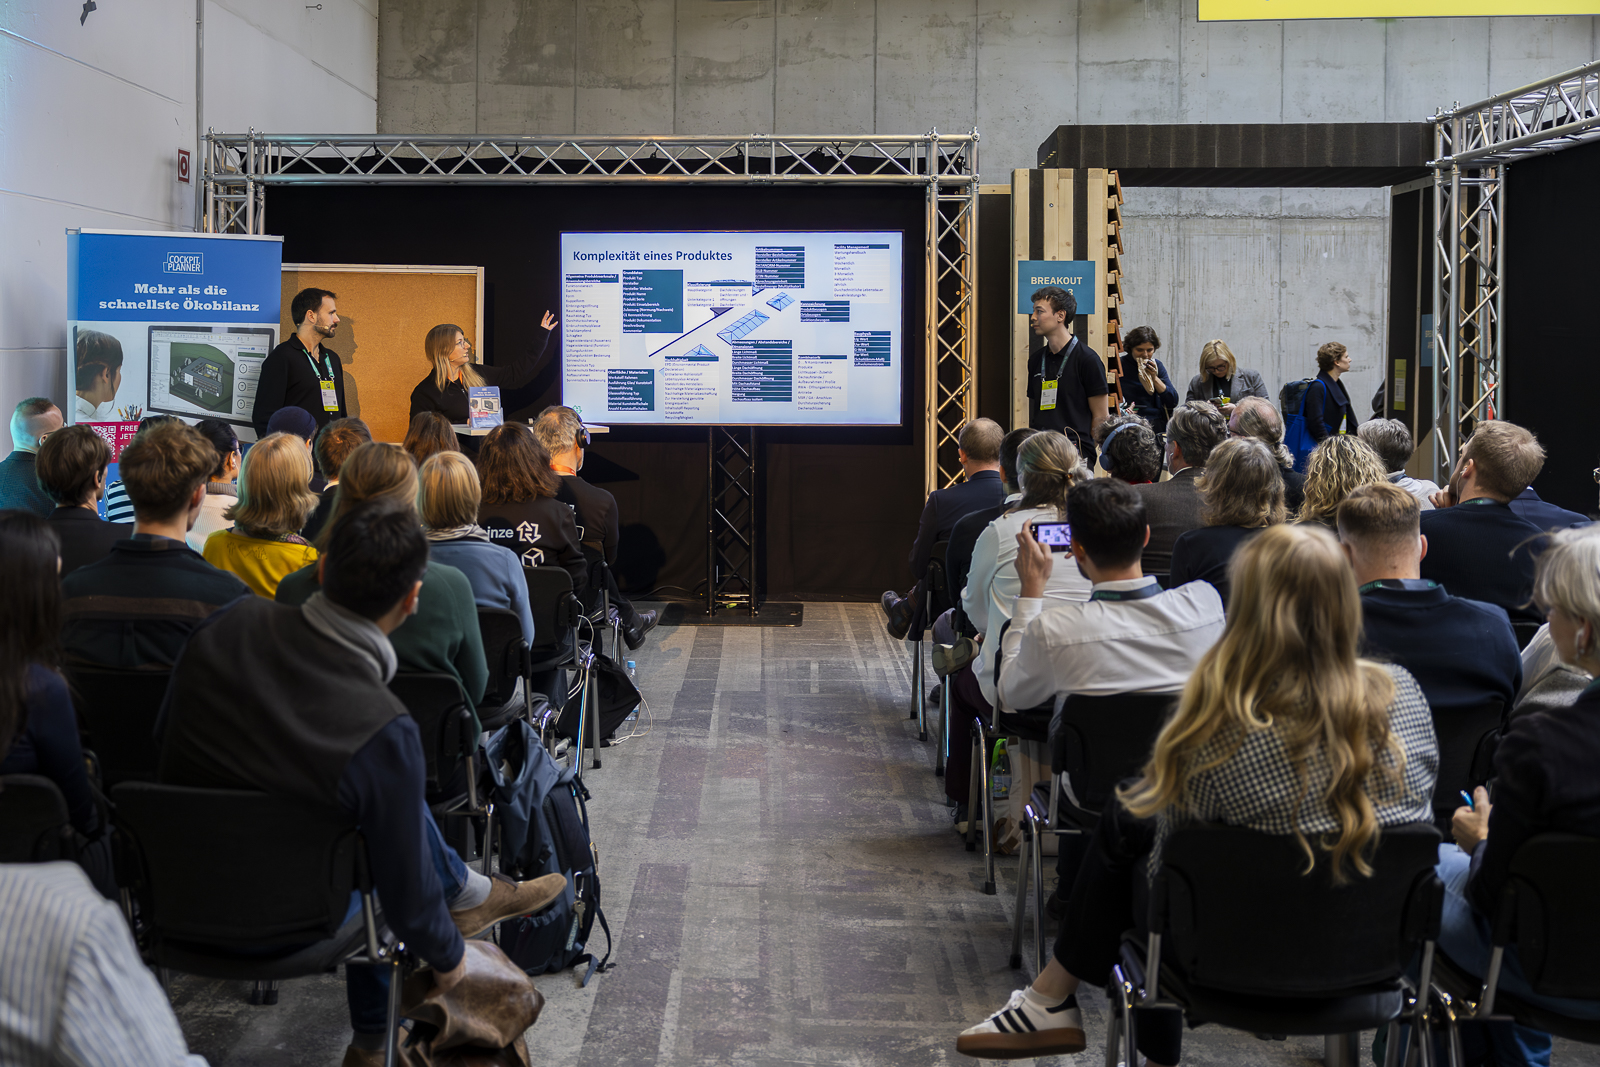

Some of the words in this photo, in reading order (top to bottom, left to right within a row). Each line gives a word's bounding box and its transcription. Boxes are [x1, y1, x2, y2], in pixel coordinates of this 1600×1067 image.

[573, 250, 640, 262] Komplexität
[644, 252, 672, 260] eines
[676, 250, 732, 260] Produktes
[167, 263, 200, 272] PLANNER
[134, 284, 175, 294] Mehr
[178, 285, 200, 295] als
[204, 285, 227, 295] die
[99, 299, 180, 310] schnellste
[183, 298, 260, 311] Ökobilanz
